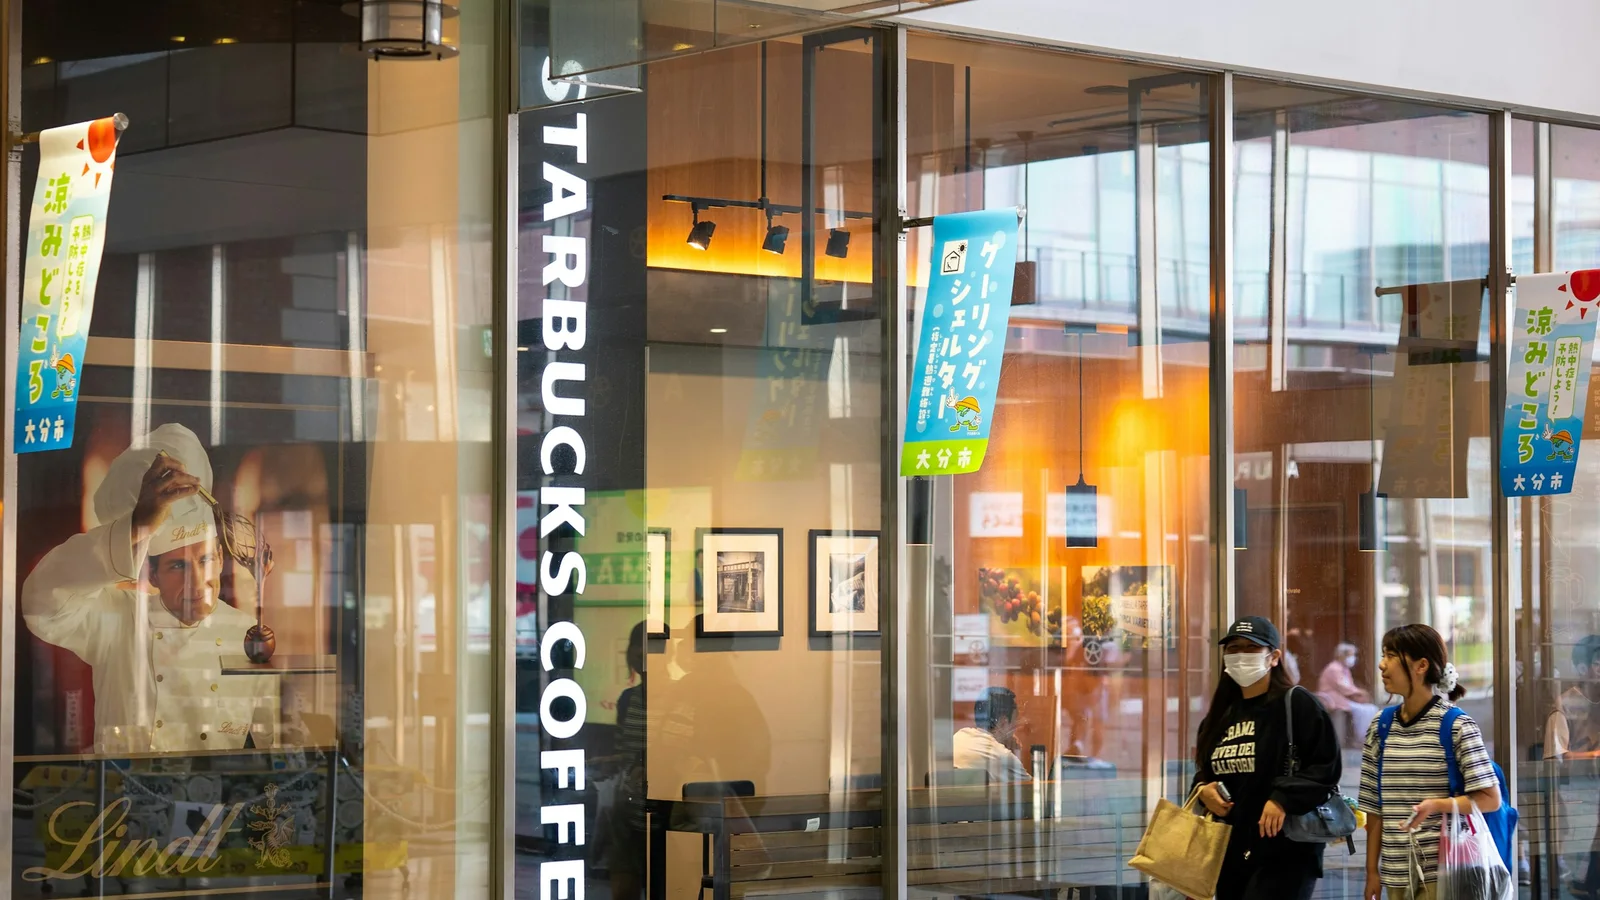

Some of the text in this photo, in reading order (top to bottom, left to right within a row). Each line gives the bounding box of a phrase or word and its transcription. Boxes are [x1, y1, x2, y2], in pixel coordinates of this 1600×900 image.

[29, 172, 71, 405] 涼みどころ
[541, 55, 588, 597] STARBUCKS
[961, 240, 999, 391] クーリング
[937, 278, 972, 420] シェルター
[1518, 305, 1554, 464] 涼みどころ
[1565, 342, 1579, 391] 熱中症を
[24, 414, 65, 445] 大分市
[915, 446, 973, 471] 大分市
[1512, 471, 1564, 492] 大分市
[170, 523, 201, 543] Lindt
[21, 797, 246, 882] Lindt
